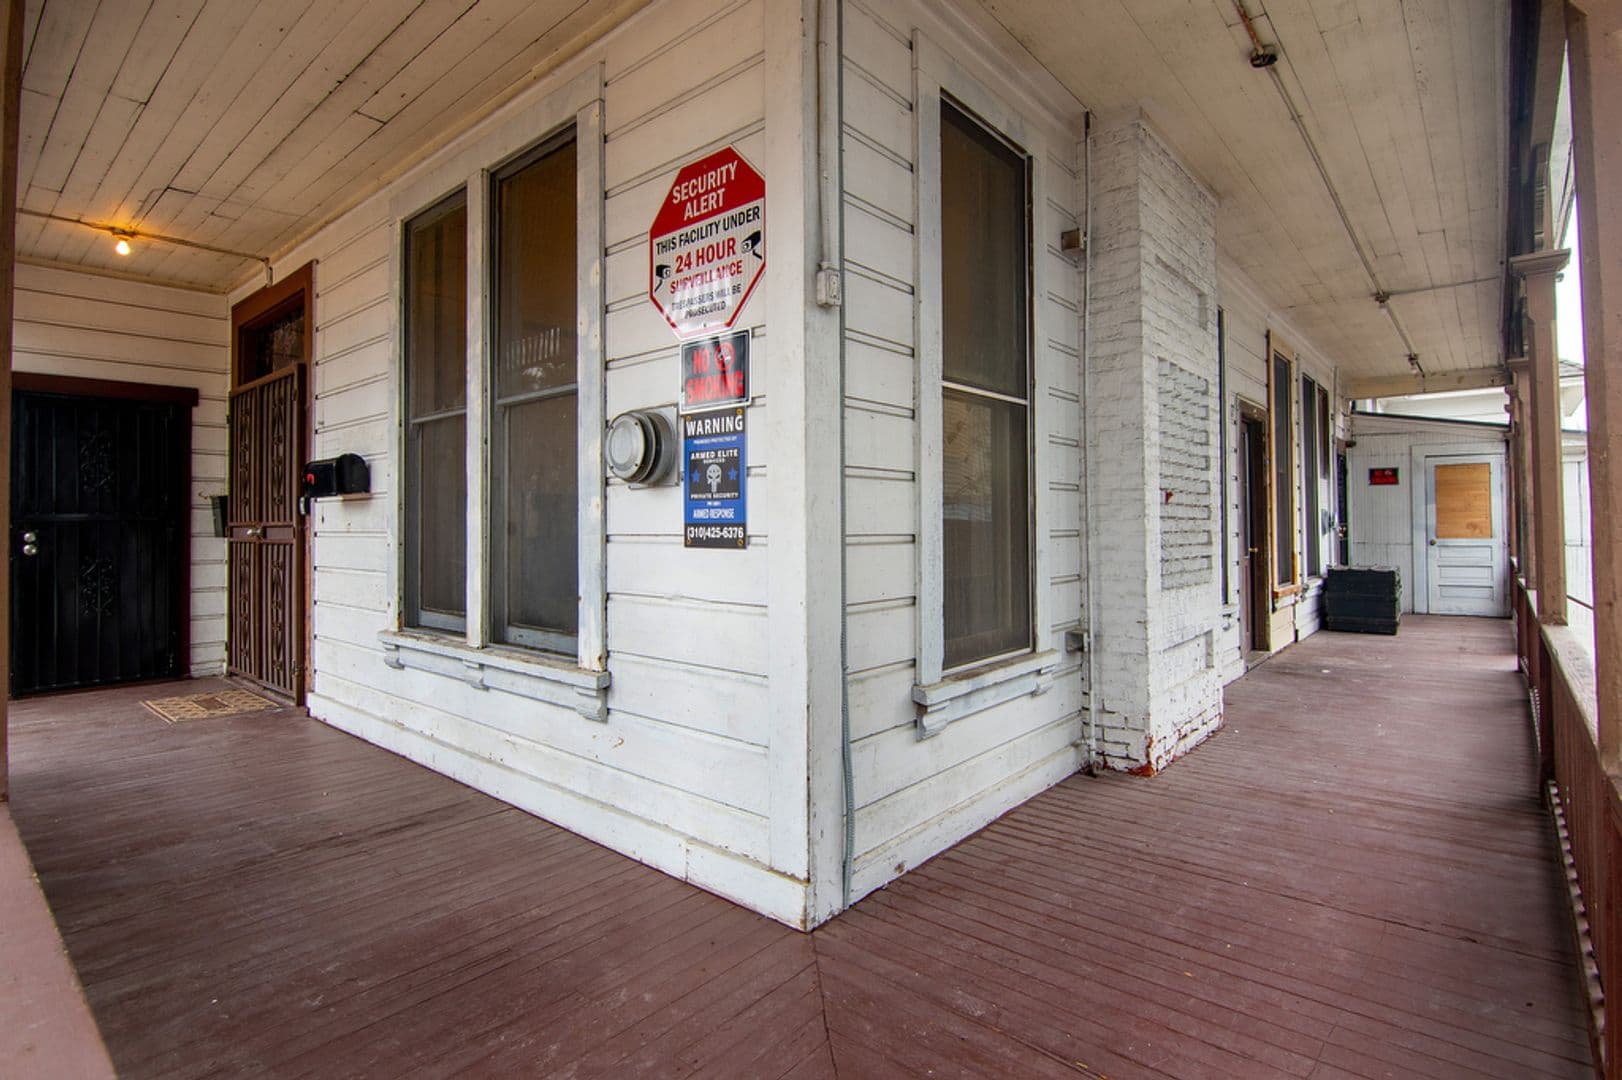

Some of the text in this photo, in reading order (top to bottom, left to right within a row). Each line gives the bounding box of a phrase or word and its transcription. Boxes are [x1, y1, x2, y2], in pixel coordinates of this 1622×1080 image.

[672, 160, 738, 204] SECURITY
[684, 188, 726, 221] ALERT
[656, 205, 760, 256] THIS FACILITY UNDER
[675, 237, 736, 273] 24 HOUR
[670, 260, 743, 294] SURVEILLANCE
[732, 284, 742, 295] BE
[693, 349, 710, 374] NO
[687, 370, 743, 404] SMOKING
[686, 415, 743, 436] WARNING
[690, 449, 738, 460] ARMED ELITE
